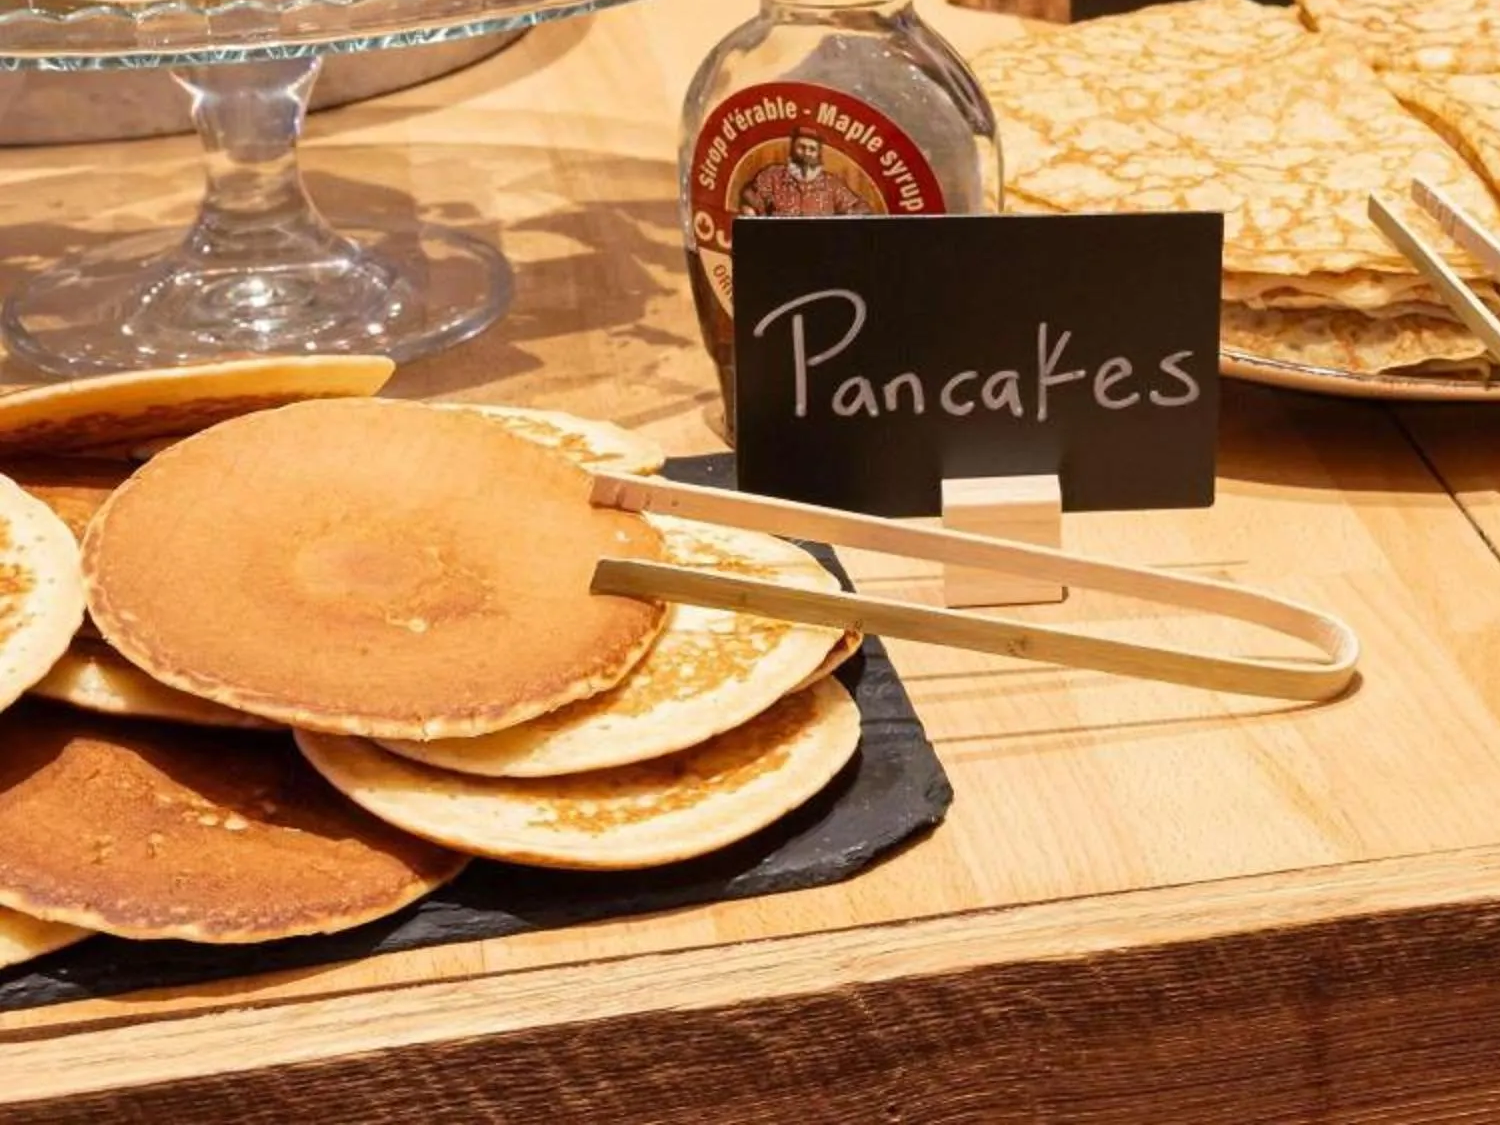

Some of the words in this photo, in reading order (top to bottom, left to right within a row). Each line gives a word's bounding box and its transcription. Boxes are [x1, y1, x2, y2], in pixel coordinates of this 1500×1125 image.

[722, 95, 798, 141] d'érable
[816, 102, 884, 153] Maple
[879, 150, 925, 212] syrup
[753, 288, 1201, 422] Pancakes
